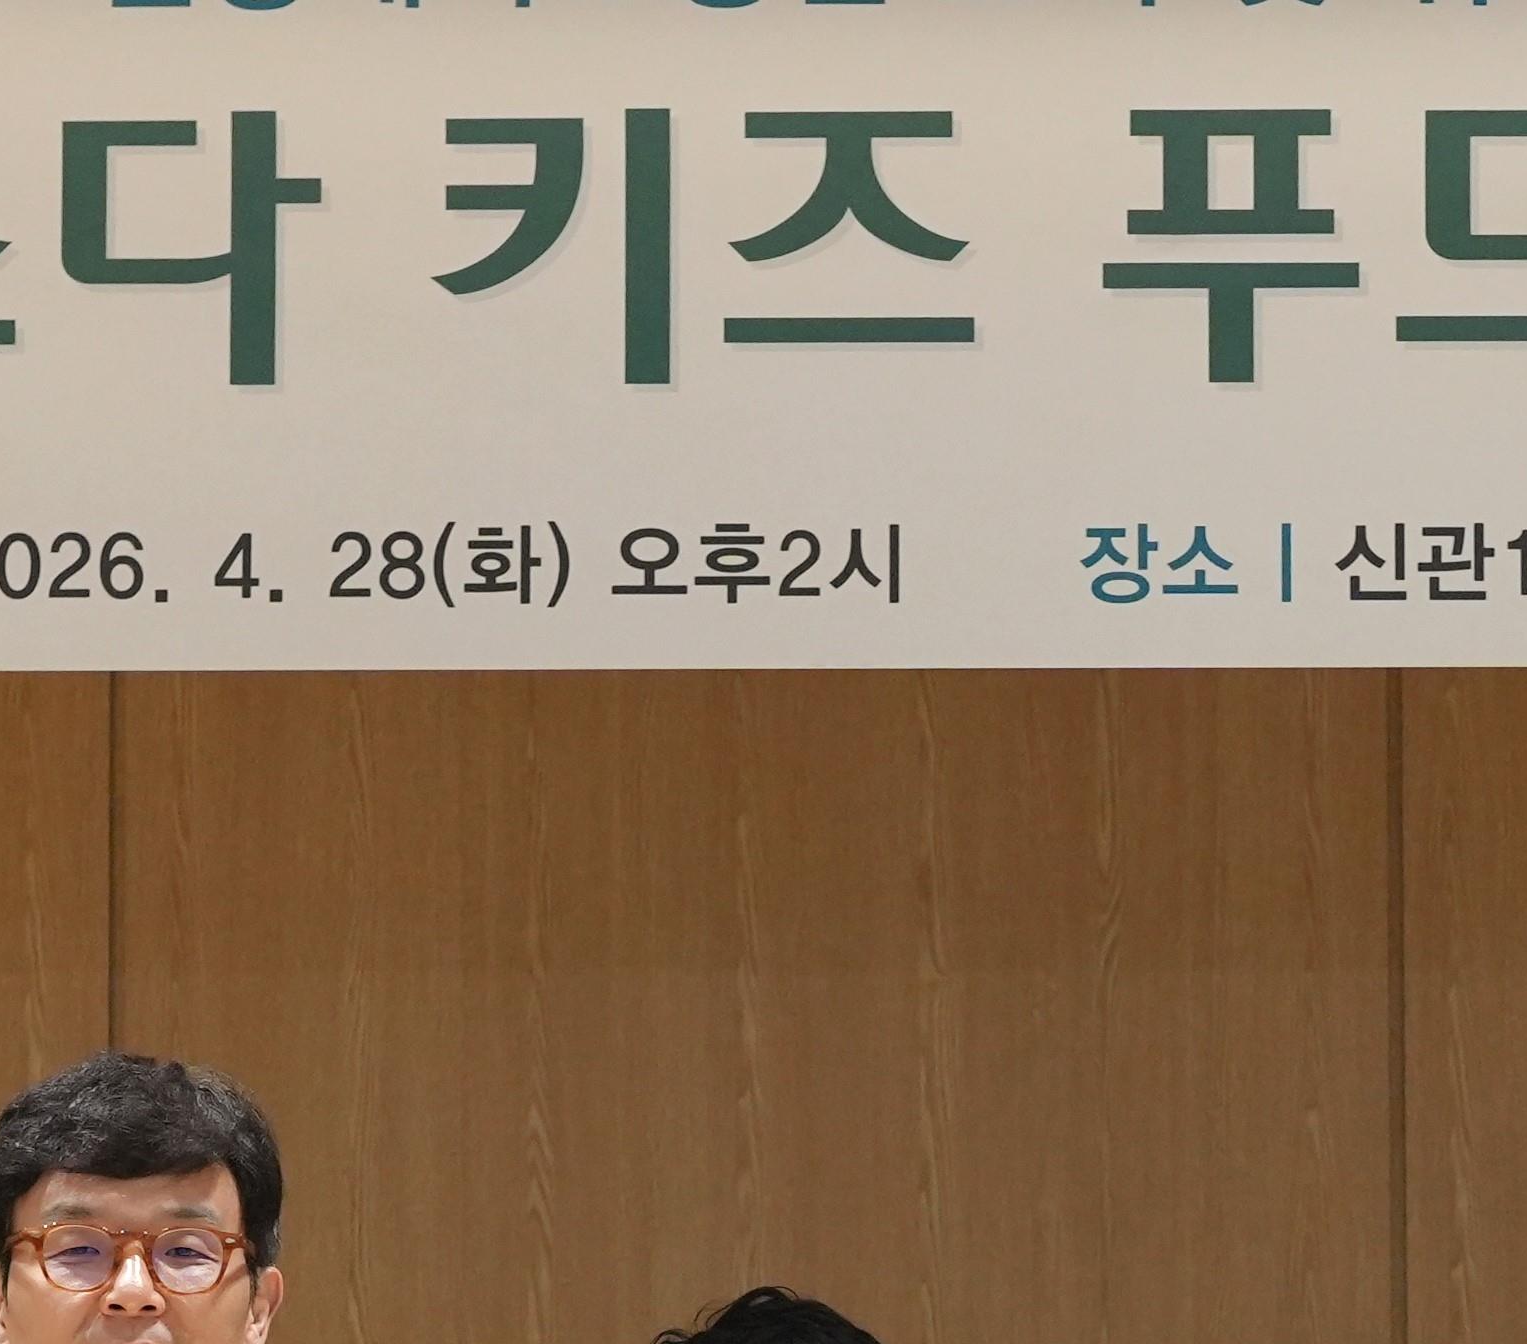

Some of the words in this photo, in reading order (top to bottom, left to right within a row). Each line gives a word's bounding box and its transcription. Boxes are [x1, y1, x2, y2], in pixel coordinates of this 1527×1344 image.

[432, 109, 974, 384] 키즈
[215, 533, 282, 602] 4.
[330, 521, 569, 607] 28(화)
[612, 524, 899, 603] 오후2시
[1081, 524, 1238, 603] 장소
